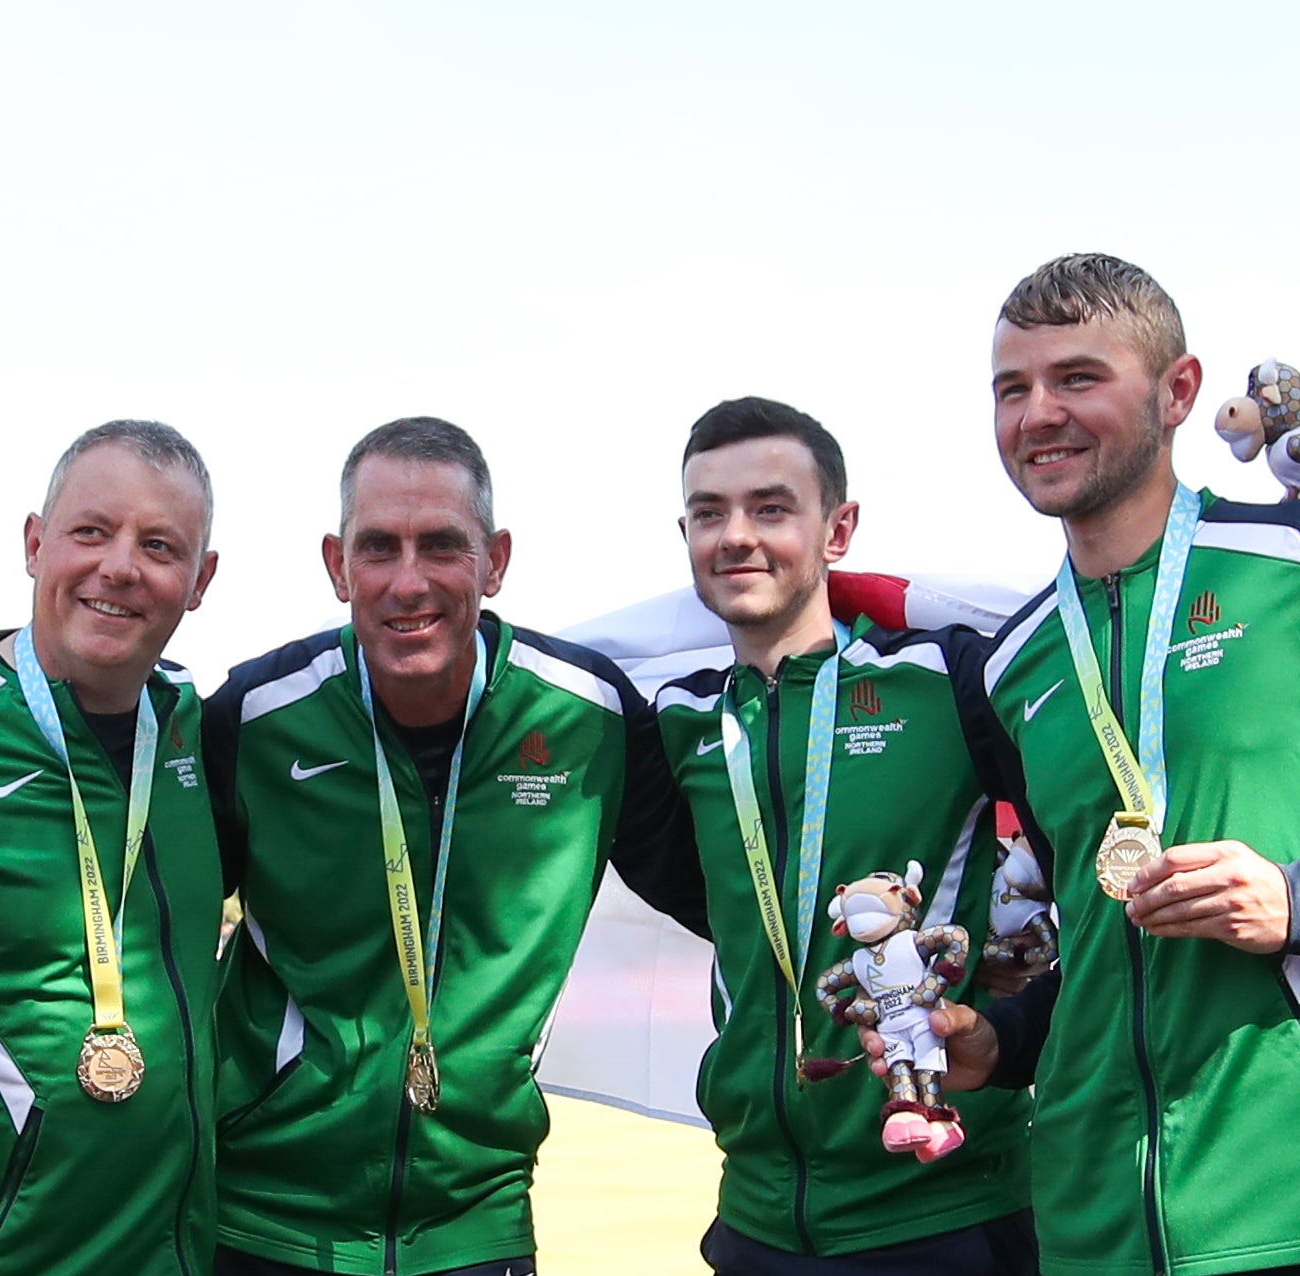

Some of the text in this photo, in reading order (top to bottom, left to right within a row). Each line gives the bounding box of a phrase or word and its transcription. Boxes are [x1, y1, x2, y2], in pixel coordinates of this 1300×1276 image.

[1186, 641, 1218, 657] games
[1180, 649, 1224, 667] NORTHERN
[1185, 657, 1220, 671] IRELAND
[835, 723, 903, 735] ommonwealth
[849, 732, 881, 742] games
[1102, 723, 1120, 752] 2022
[844, 741, 887, 750] NORTHERN
[849, 747, 883, 756] IRELAND
[497, 774, 567, 785] commonwealth
[517, 783, 547, 791] games
[511, 792, 551, 800] NORTHERN
[84, 857, 109, 964] BIRMINGHAM 2022
[754, 859, 786, 960] BIRMINGHAM 2022
[395, 883, 419, 986] BIRMINGHAM 2022
[883, 997, 903, 1010] 2022
